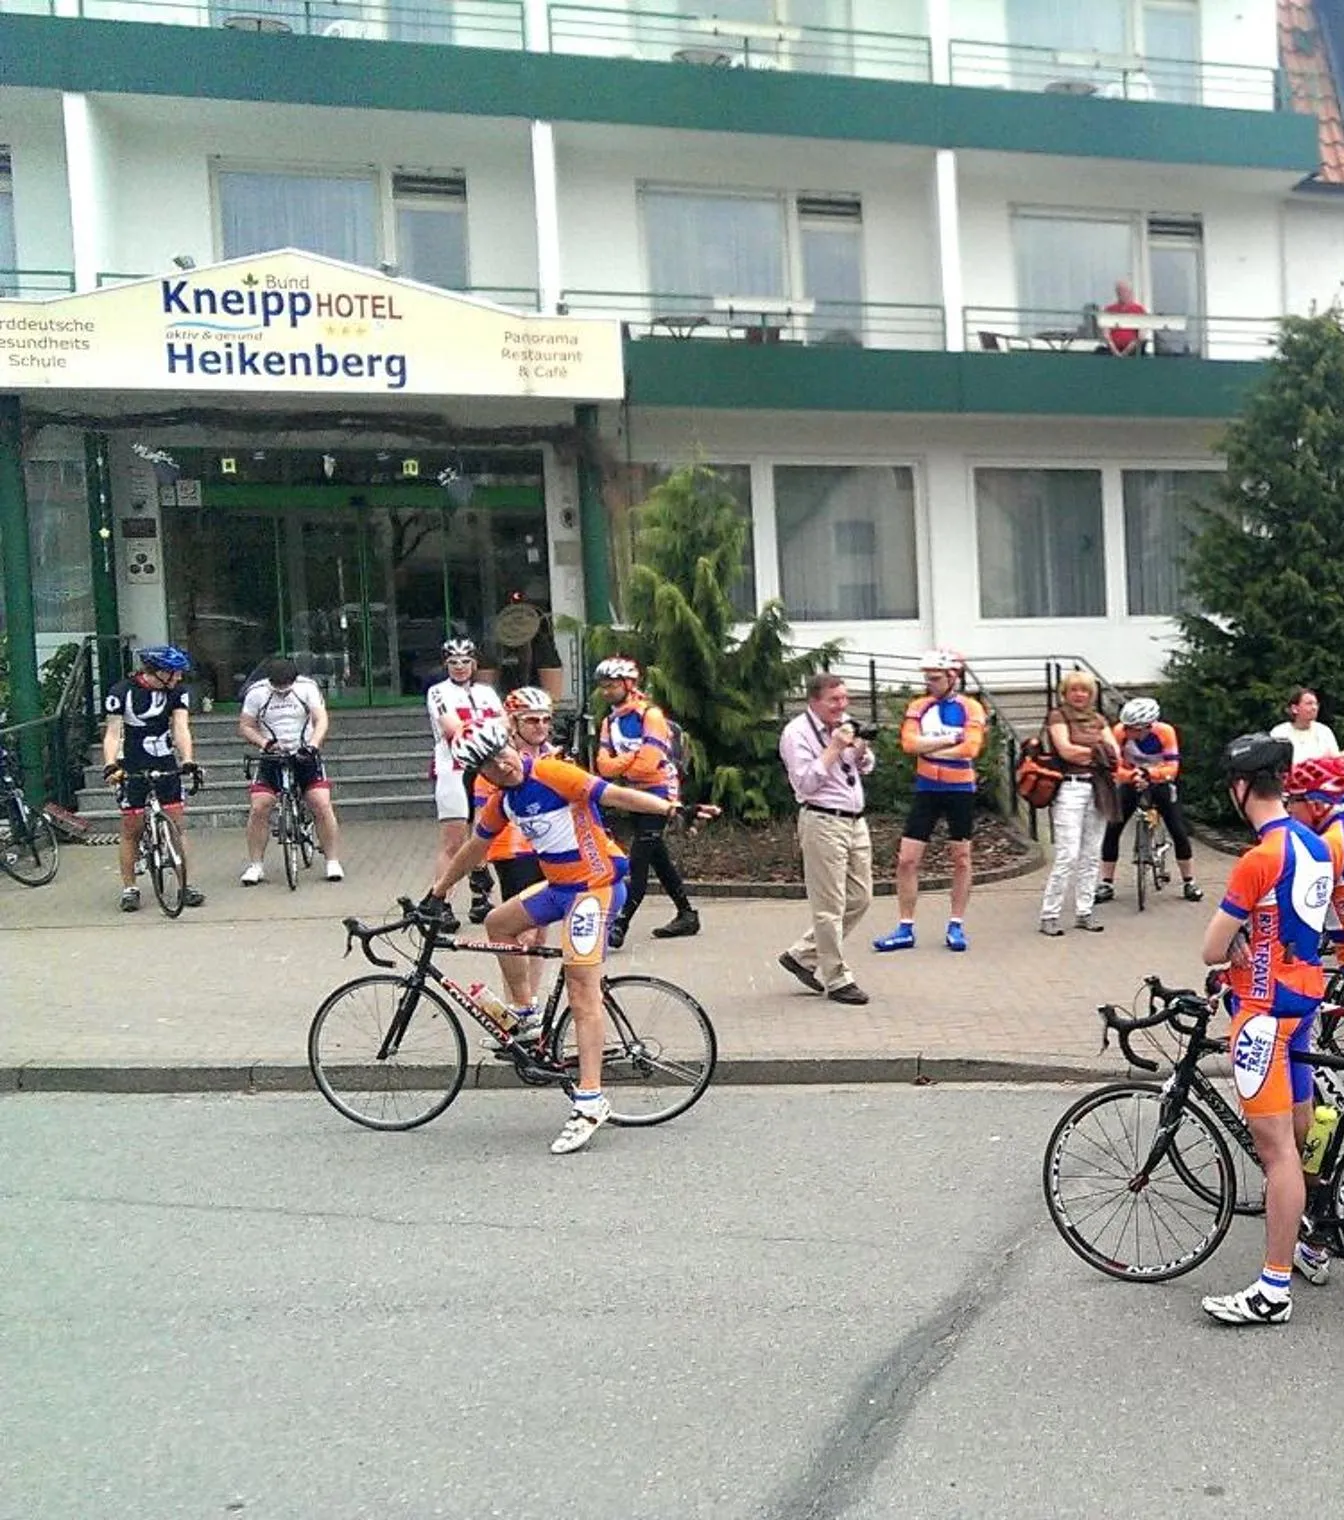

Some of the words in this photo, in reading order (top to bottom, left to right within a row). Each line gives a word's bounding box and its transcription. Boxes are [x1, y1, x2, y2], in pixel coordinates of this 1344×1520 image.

[265, 274, 309, 289] Bund
[162, 280, 312, 328] Kneipp
[316, 293, 403, 320] HOTEL
[166, 329, 199, 341] aktiv
[202, 330, 213, 341] &
[215, 330, 263, 342] gesund
[504, 331, 578, 344] Panorama
[9, 354, 67, 368] Schule
[501, 347, 583, 363] Restaurant
[167, 342, 407, 389] Heikenberg
[534, 364, 568, 378] Café
[573, 912, 586, 938] RV
[1259, 912, 1272, 937] RV
[1251, 940, 1271, 1000] TRAVE
[1235, 1029, 1254, 1070] RV
[1246, 1035, 1268, 1073] TRAVE
